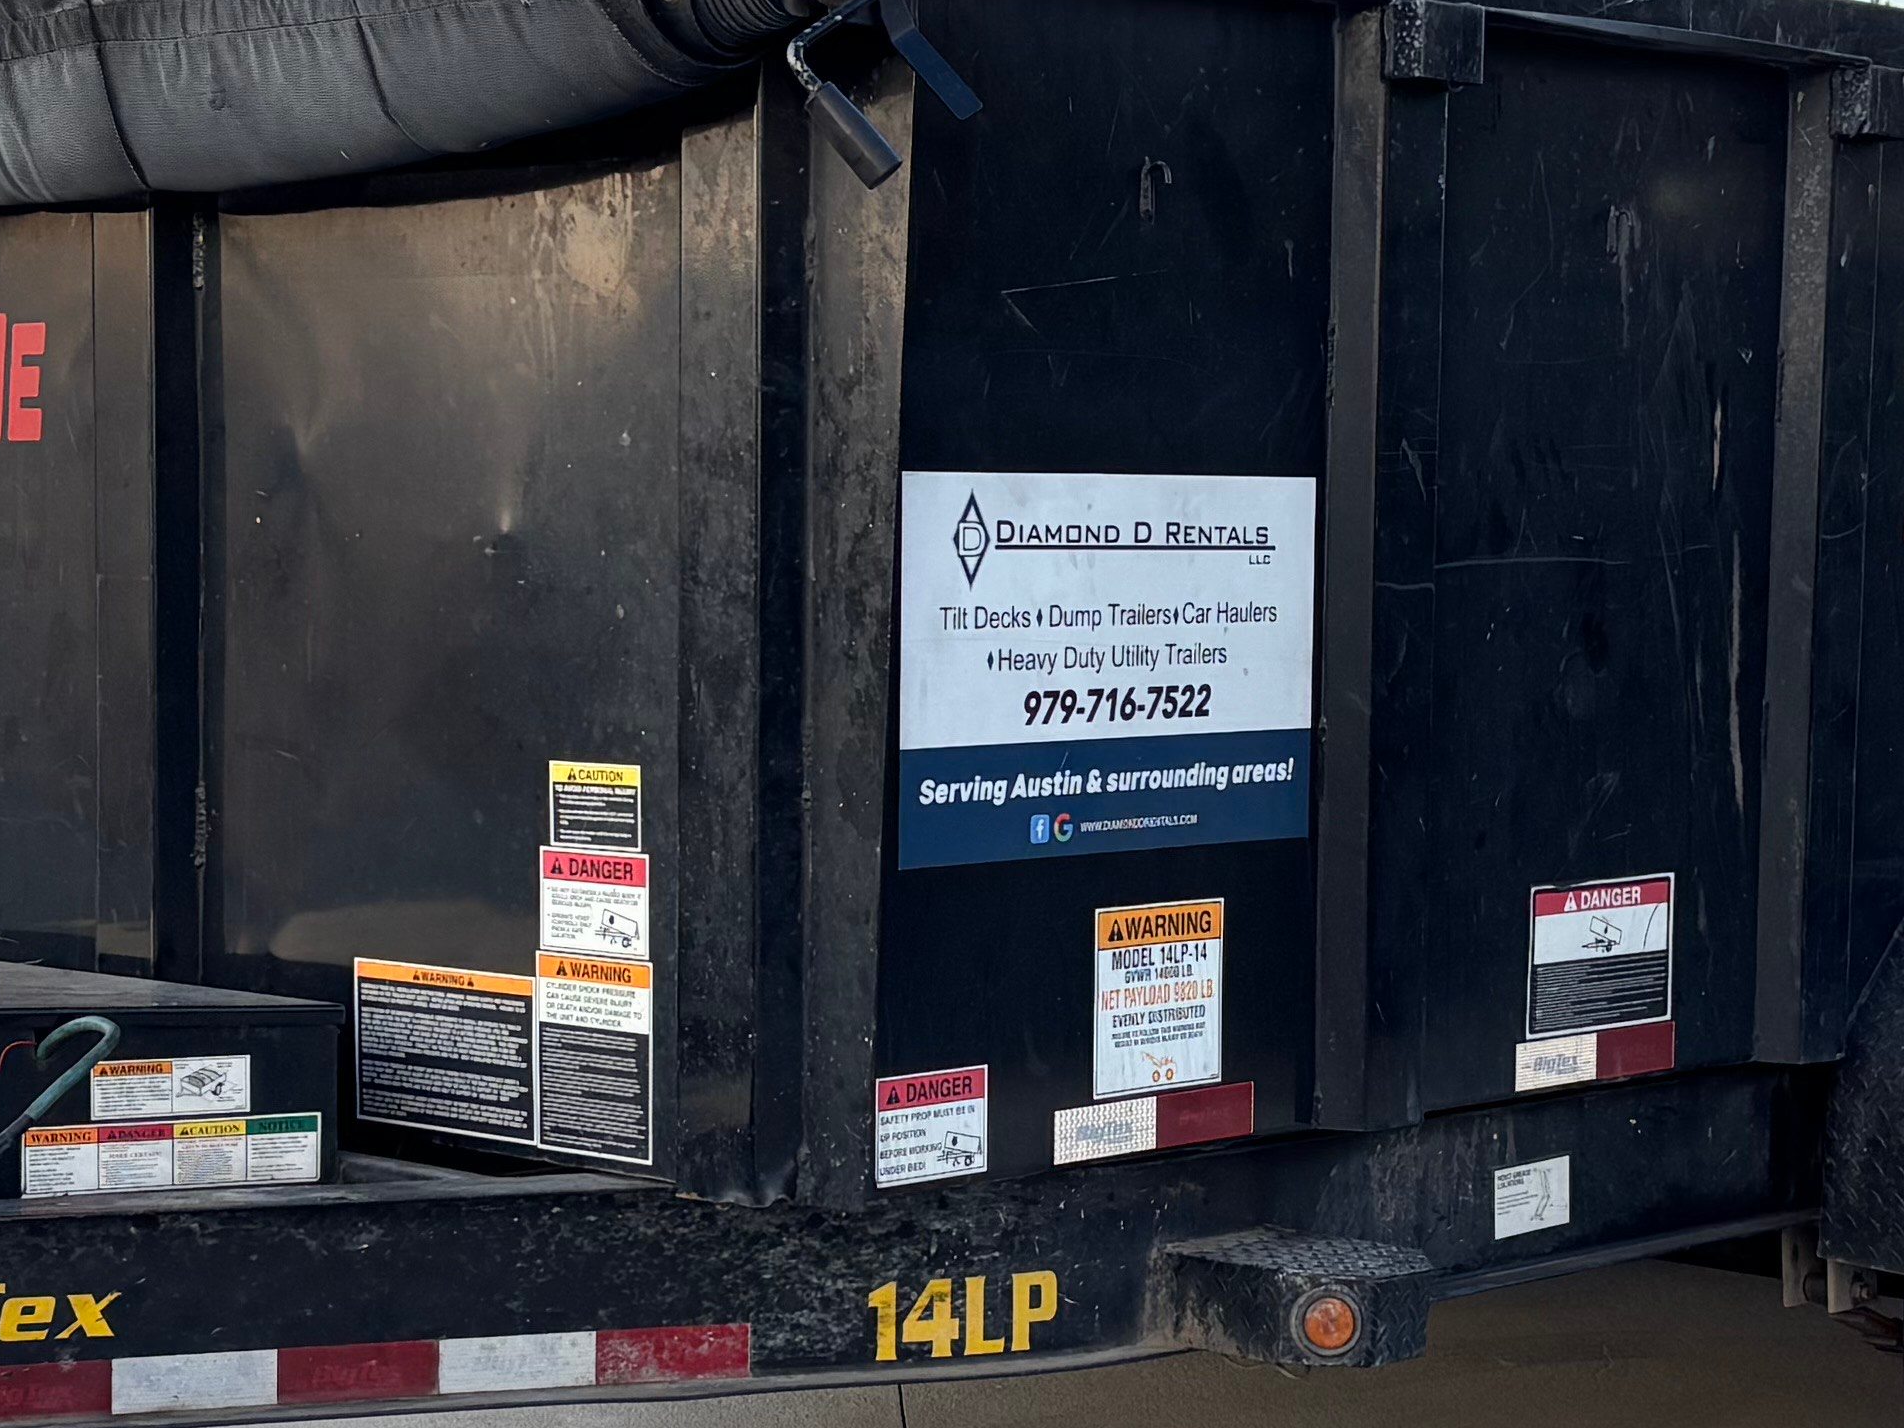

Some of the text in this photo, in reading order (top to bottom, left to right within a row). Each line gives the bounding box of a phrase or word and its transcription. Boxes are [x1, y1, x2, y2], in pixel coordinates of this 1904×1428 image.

[996, 520, 1270, 545] DIAMOND D RENTALS
[1248, 554, 1272, 566] LLC
[940, 601, 1277, 631] Tilt Decks Dump Trailers Car Haulers
[998, 642, 1227, 675] Heavy Duty Utility Trailers
[1023, 684, 1212, 726] 979-716-7522
[578, 769, 623, 782] CAUTION
[919, 758, 1294, 806] Serving Austin & surrounding areas!
[569, 858, 633, 881] DANGER
[1581, 886, 1641, 910] DANGER
[1125, 910, 1212, 940] WARNING
[1112, 942, 1207, 970] MODEL 14LP-14
[421, 972, 465, 986] WARNING
[570, 962, 632, 983] WARNING
[1101, 989, 1121, 1011] NET
[1124, 983, 1171, 1008] PAYLOAD
[109, 1063, 163, 1075] WARNING
[906, 1075, 972, 1103] DANGER
[31, 1131, 92, 1143] WARNING
[190, 1124, 240, 1136] CAUTION
[867, 1270, 1058, 1362] 14LP
